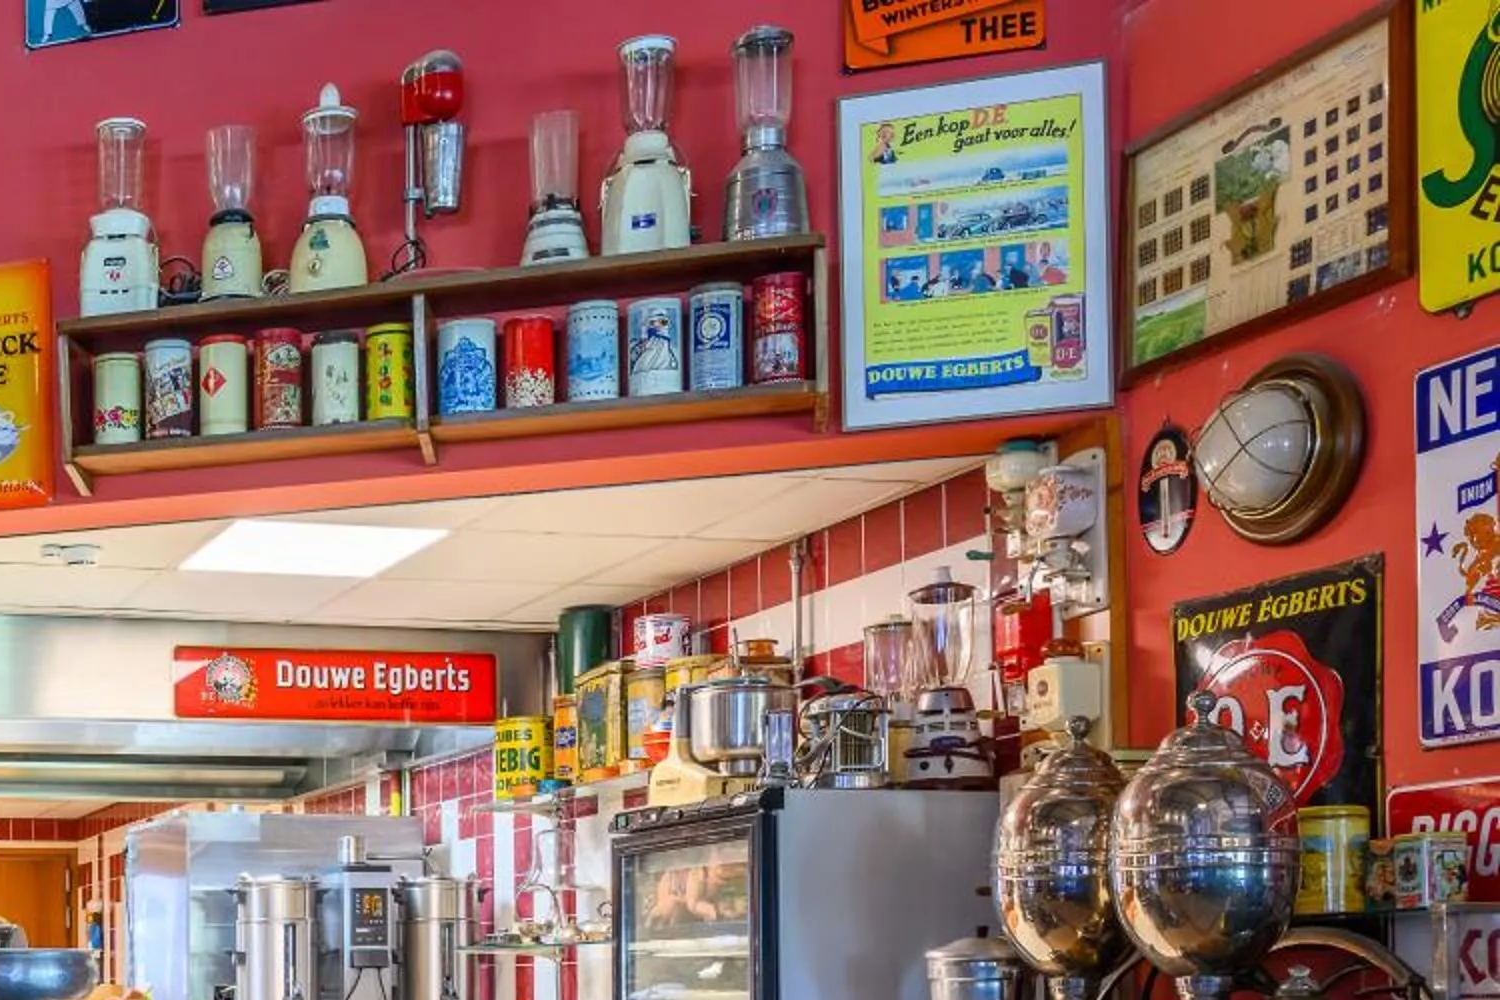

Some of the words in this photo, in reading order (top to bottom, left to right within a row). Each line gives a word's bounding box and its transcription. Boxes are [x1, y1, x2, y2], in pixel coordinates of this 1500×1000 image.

[960, 11, 1036, 44] THEE
[900, 122, 934, 147] Een
[936, 115, 970, 138] kop
[952, 127, 991, 153] gaat
[994, 126, 1029, 141] voor
[1029, 118, 1077, 140] alles!
[867, 365, 937, 385] DOUWE
[941, 354, 1025, 379] EGBERTS
[1177, 602, 1252, 643] DOUWE
[1257, 577, 1367, 624] EGBERTS
[276, 660, 366, 690] Douwe
[373, 660, 470, 695] Egberts
